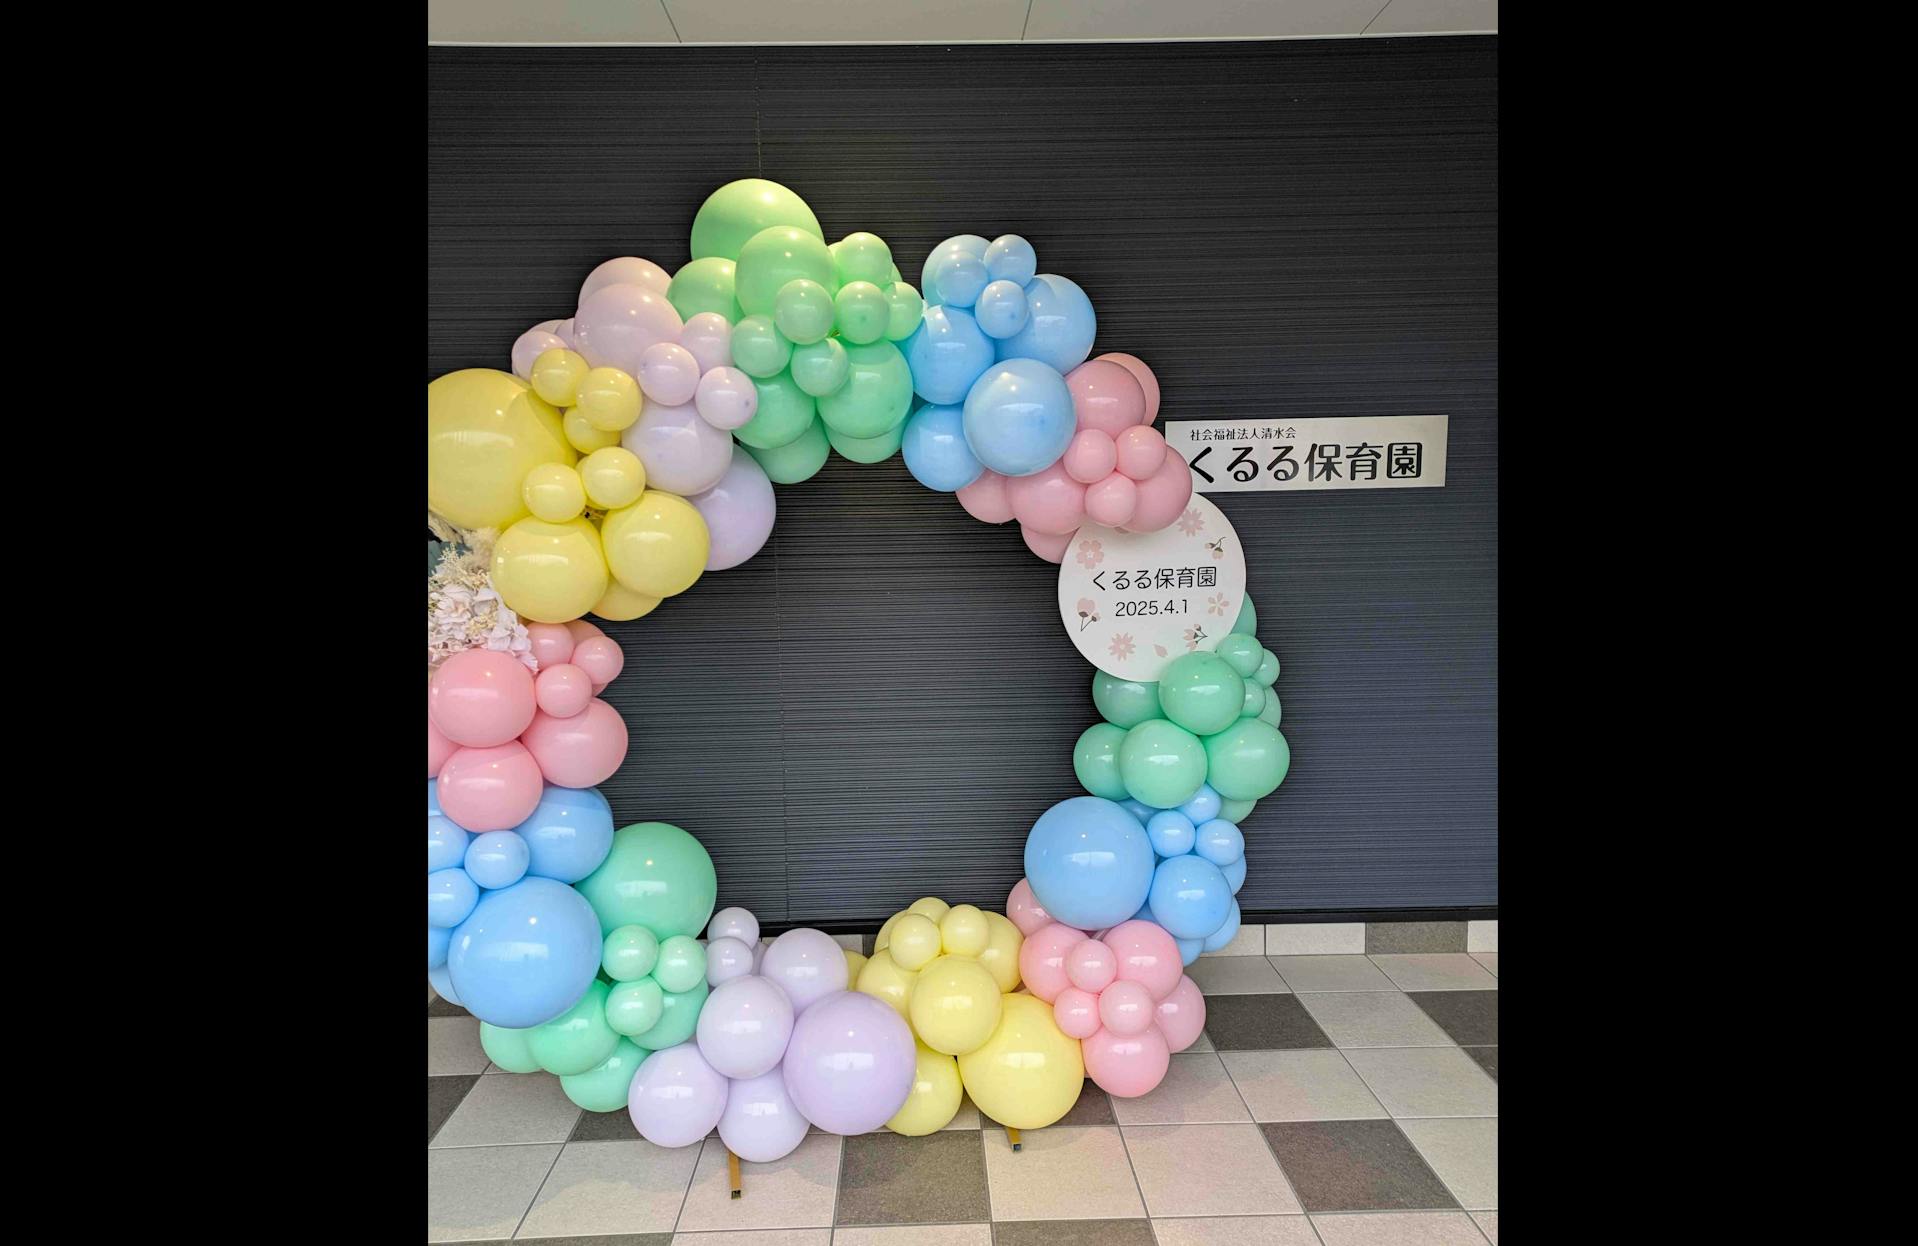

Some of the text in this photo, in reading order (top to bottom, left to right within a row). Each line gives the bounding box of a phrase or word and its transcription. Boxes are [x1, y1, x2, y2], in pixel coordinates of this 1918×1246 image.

[1190, 427, 1296, 441] 社会福祉法人清水会
[1189, 442, 1422, 483] くるる保育園
[1092, 566, 1217, 591] くるる保育園
[1115, 599, 1188, 617] 2025.4.1
